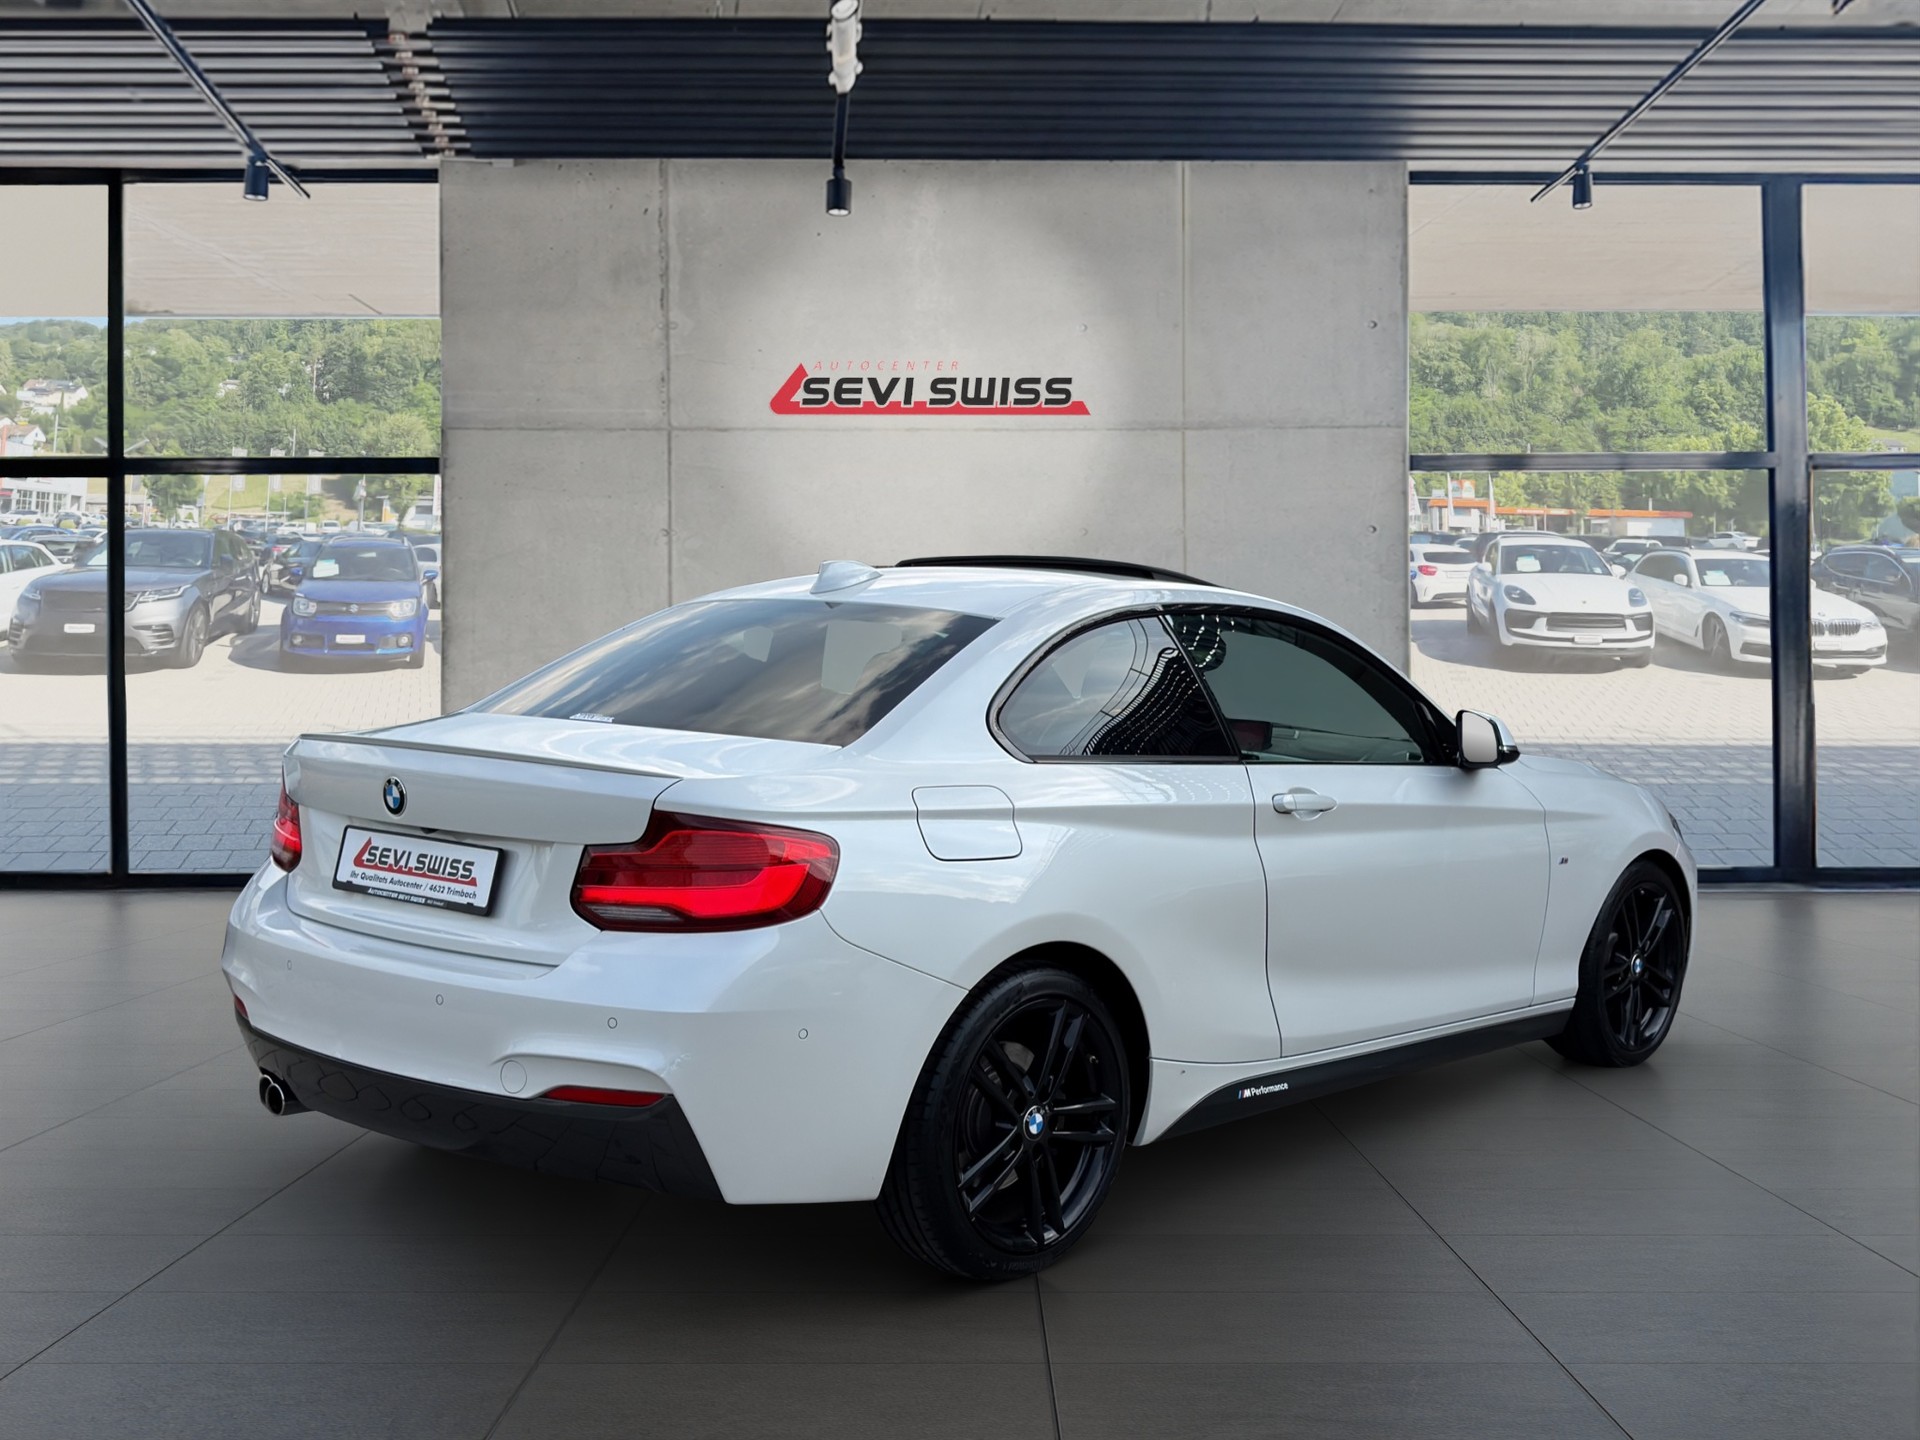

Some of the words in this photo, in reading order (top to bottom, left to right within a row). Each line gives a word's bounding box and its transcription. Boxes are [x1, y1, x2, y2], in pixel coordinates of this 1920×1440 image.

[813, 360, 960, 371] AUTOCENTER
[801, 377, 914, 406] SEVI
[928, 377, 1073, 406] SWISS
[365, 845, 412, 870] SEVI
[413, 853, 475, 880] SWISS
[350, 870, 359, 879] Ihr
[389, 877, 423, 890] Autocenter
[429, 884, 446, 894] 4632
[446, 886, 477, 899] Trimbach
[1251, 1082, 1289, 1097] Performance
